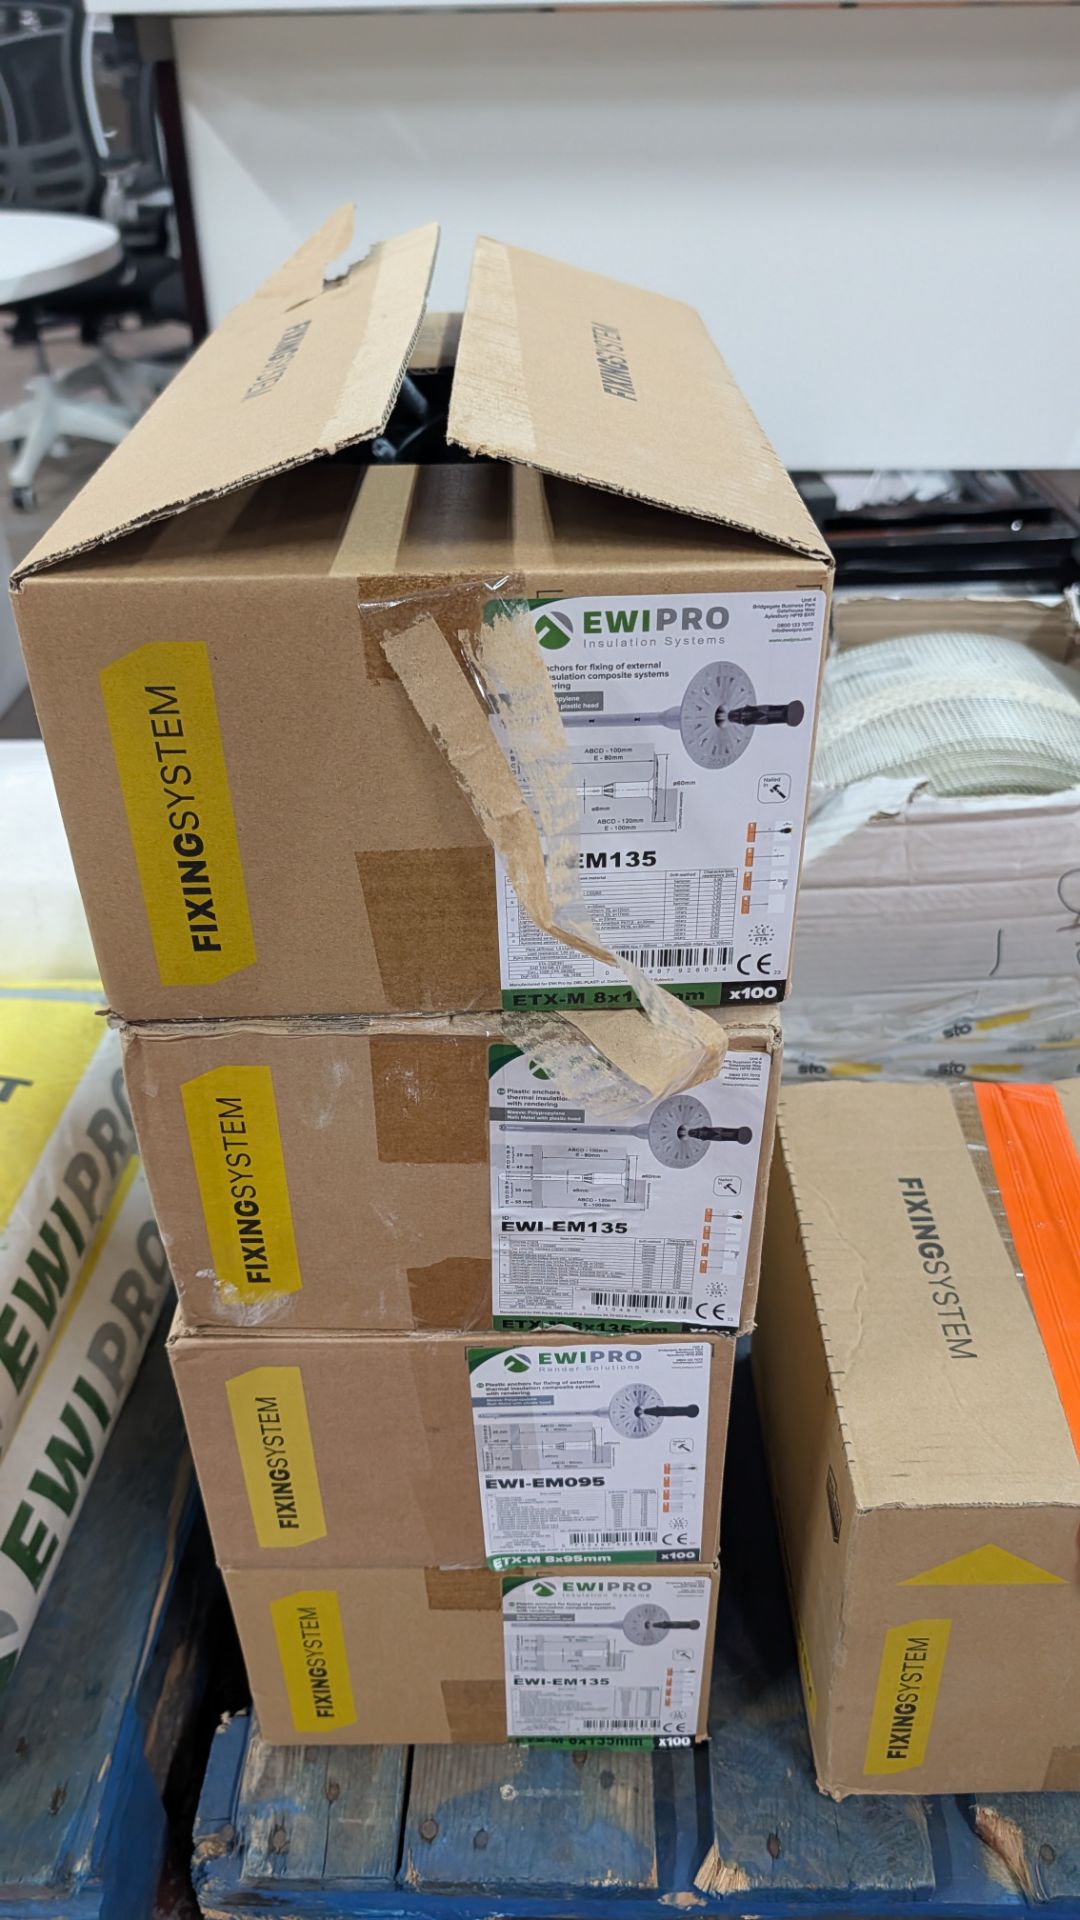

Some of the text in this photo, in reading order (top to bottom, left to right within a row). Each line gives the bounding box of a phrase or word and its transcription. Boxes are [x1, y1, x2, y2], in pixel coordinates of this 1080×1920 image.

[590, 321, 637, 401] FIXINGSYSTEM
[584, 606, 729, 634] EWIPRO
[584, 634, 726, 648] Insulation Systems
[590, 663, 613, 672] fixing
[587, 672, 632, 681] composite
[634, 671, 669, 680] systems
[144, 685, 222, 952] FIXINGSYSTEM
[513, 992, 585, 1006] ETX-M
[730, 986, 777, 999] x100
[942, 1018, 972, 1039] sto
[798, 1061, 965, 1075] sto sto
[216, 1097, 271, 1284] FIXINGSYSTEM
[501, 1221, 628, 1234] EWI-EM135
[898, 1176, 977, 1359] FIXINGSYSTEM
[539, 1350, 642, 1364] EWIPRO
[255, 1396, 300, 1529] FIXINGSYSTEM
[486, 1476, 604, 1489] EWI-EM095
[493, 1554, 611, 1570] ETX-M 8x95mm
[661, 1551, 695, 1559] x100
[563, 1582, 652, 1592] EWIPRO
[296, 1606, 335, 1718] FIXINGSYSTEM
[886, 1635, 930, 1759] FIXINGSYSTEM
[659, 1737, 691, 1746] x100
